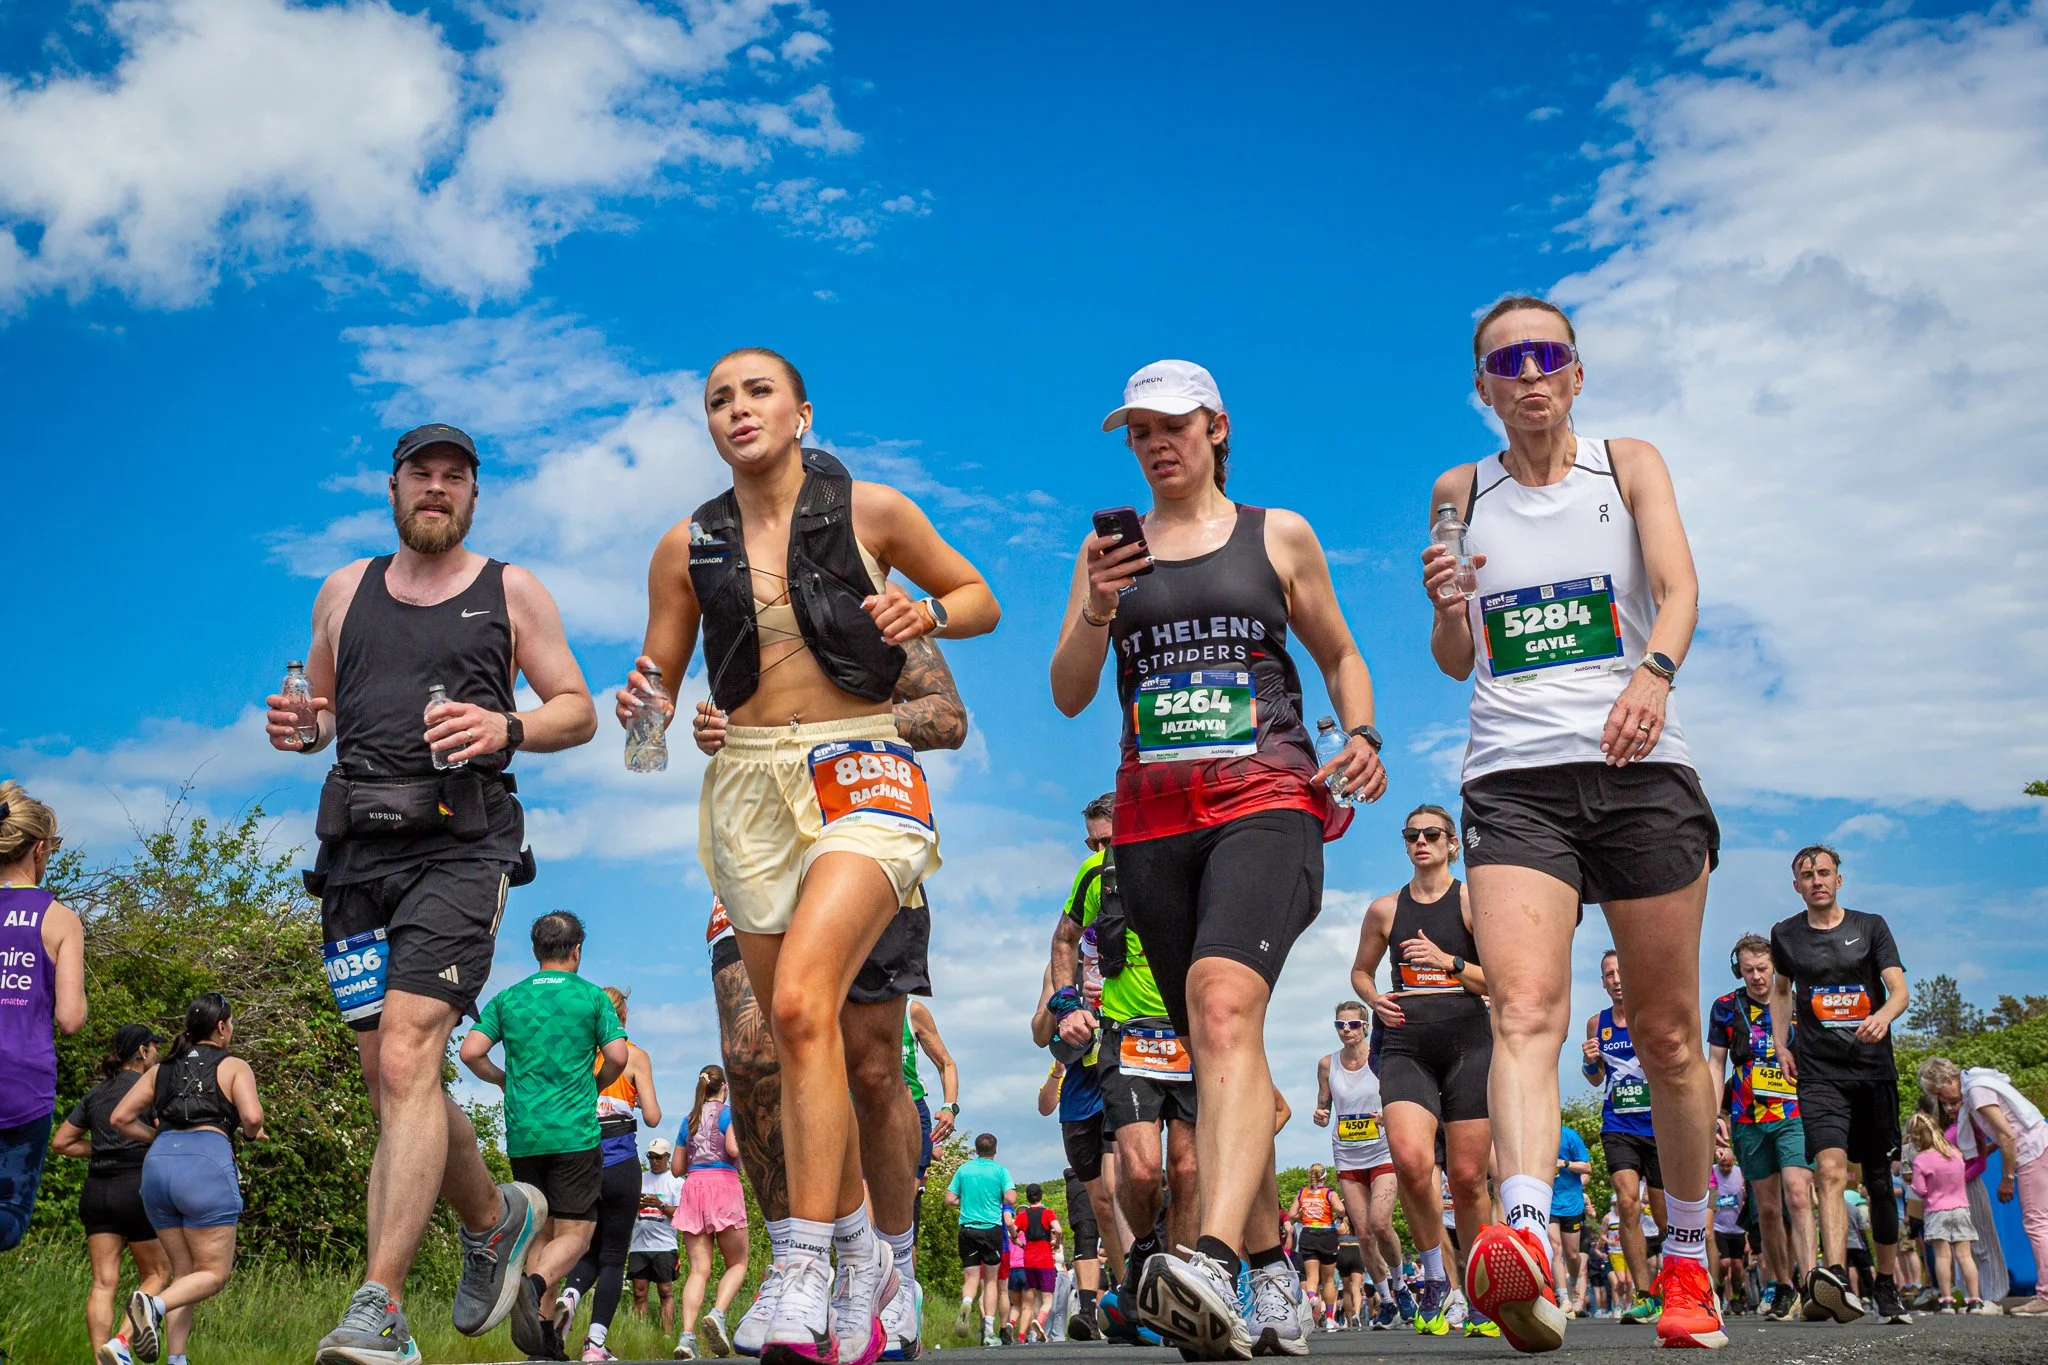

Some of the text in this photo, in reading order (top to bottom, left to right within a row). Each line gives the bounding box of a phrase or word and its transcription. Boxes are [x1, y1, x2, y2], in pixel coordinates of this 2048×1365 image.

[1134, 377, 1163, 388] KIPRUN
[1503, 600, 1592, 638] 5284
[1151, 616, 1266, 647] HELENS
[1525, 634, 1577, 653] GAYLE
[1137, 645, 1246, 675] STRIDERS
[1574, 664, 1601, 673] JustGiving
[1154, 689, 1232, 716] 5264
[1161, 719, 1226, 735] JAZZMYN
[834, 754, 914, 788] 8838
[849, 783, 913, 805] RACHAEL
[369, 812, 402, 821] KIPRUN
[3, 910, 39, 928] ALI
[1416, 973, 1448, 981] PHOEBE
[334, 976, 378, 998] THOMAS
[0, 997, 29, 1007] matter
[1822, 994, 1860, 1007] 8267
[1135, 1038, 1177, 1056] 8213
[1144, 1056, 1168, 1065] ROSS
[1760, 1068, 1783, 1080] 430
[1616, 1085, 1643, 1097] 5438
[1345, 1120, 1370, 1130] 4507
